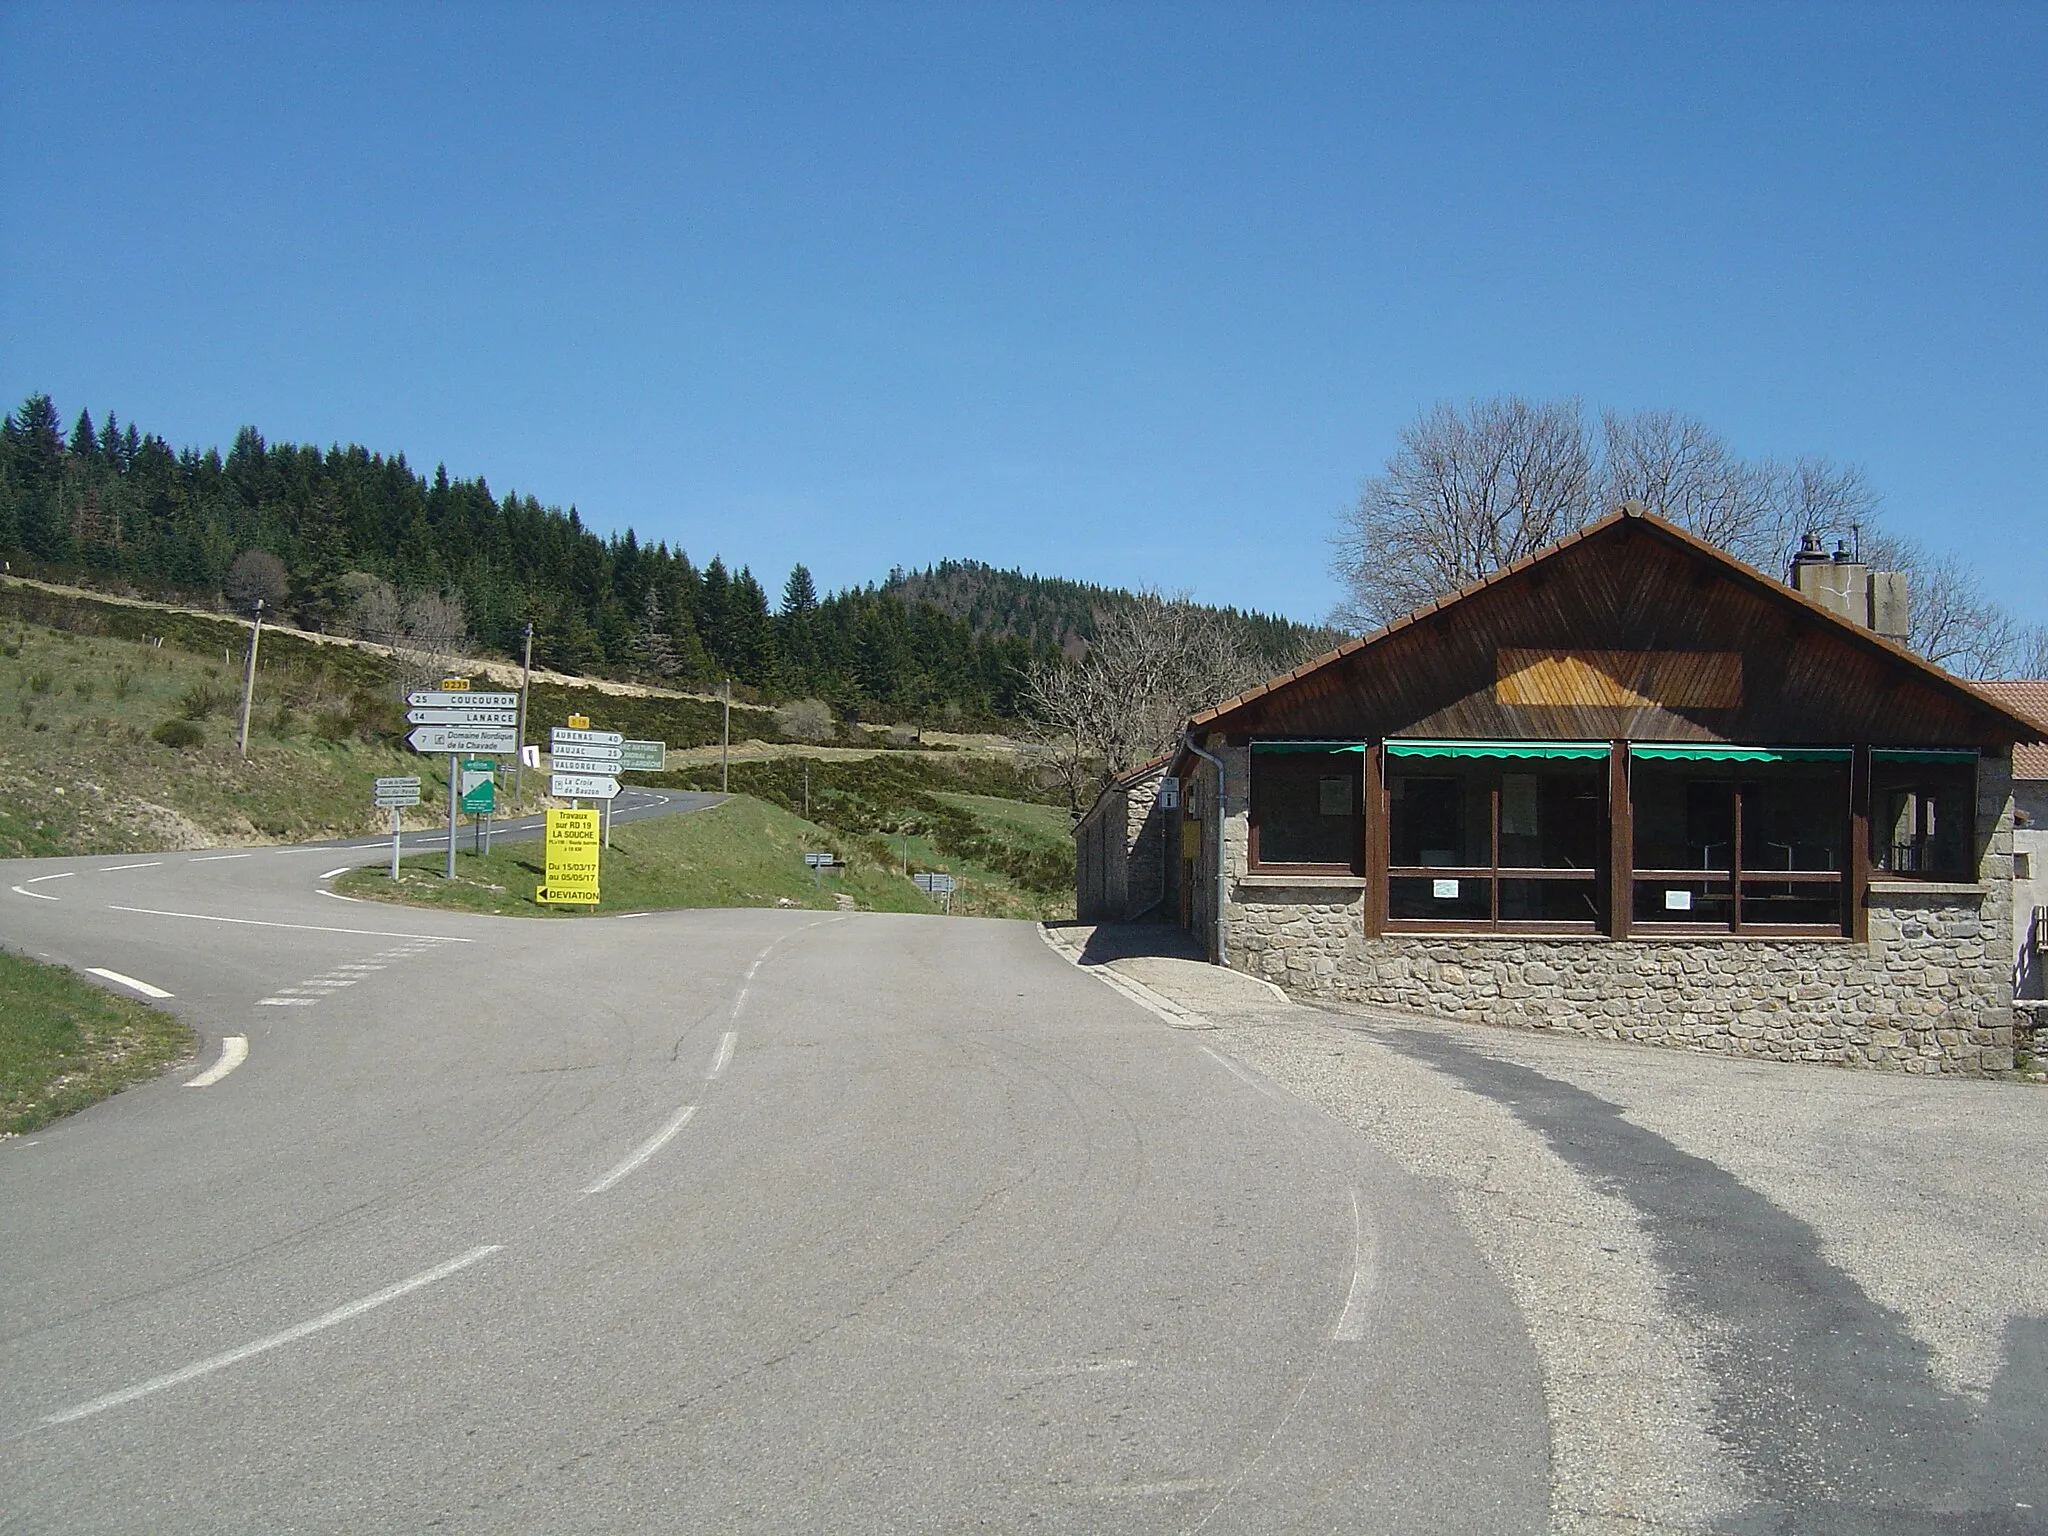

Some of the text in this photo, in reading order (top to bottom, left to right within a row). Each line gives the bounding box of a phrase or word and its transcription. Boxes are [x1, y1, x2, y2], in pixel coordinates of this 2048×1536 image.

[451, 696, 514, 705] COUCOURON
[466, 713, 514, 722] LANARCE
[421, 735, 427, 743] 7
[447, 731, 514, 742] Domaine Nordique
[555, 731, 593, 740] AUBENAS
[447, 741, 498, 750] de la Chavade
[555, 746, 586, 755] JAUJAC
[555, 761, 596, 771] VALGORGE
[607, 784, 613, 792] 5
[560, 812, 588, 820] Travaux
[569, 821, 581, 829] RD
[582, 821, 592, 829] 19
[552, 831, 594, 839] LA SOUCHE
[548, 863, 560, 871] Du
[561, 874, 595, 882] 05/05/17
[549, 891, 599, 900] DEVIATION
